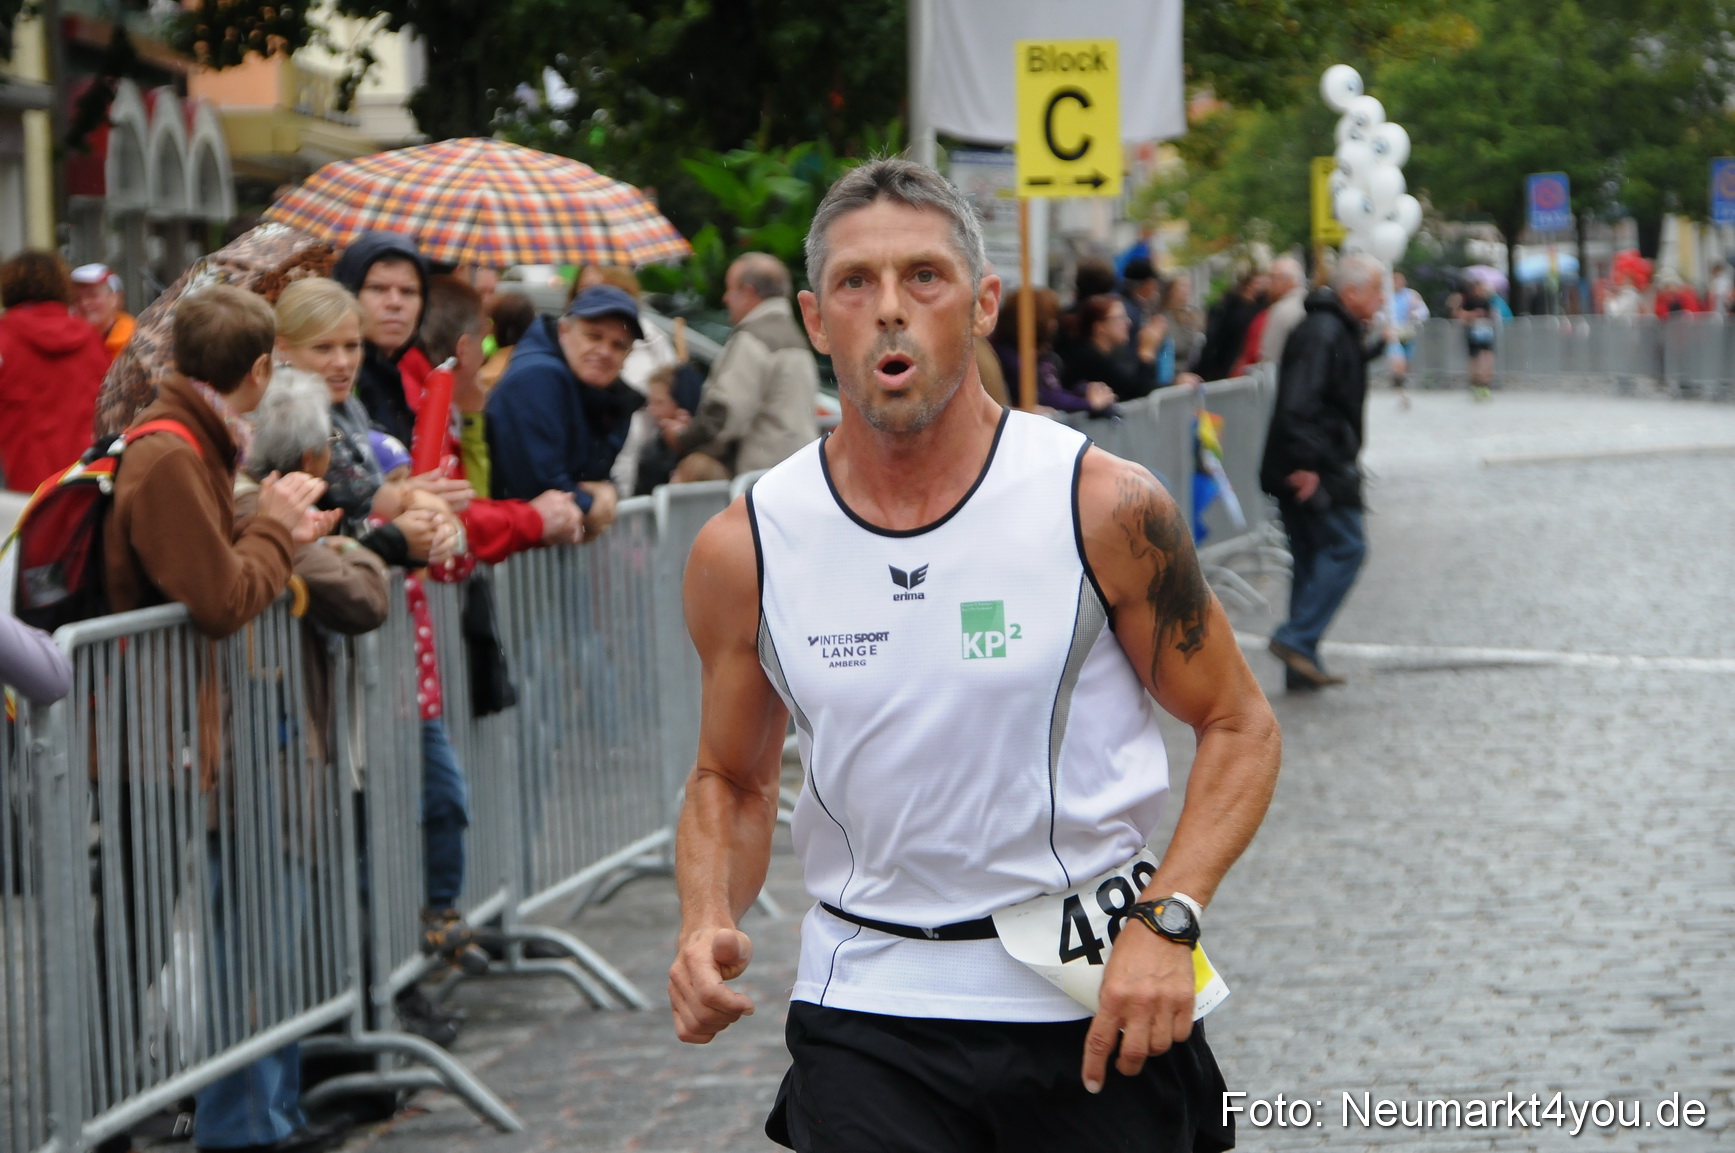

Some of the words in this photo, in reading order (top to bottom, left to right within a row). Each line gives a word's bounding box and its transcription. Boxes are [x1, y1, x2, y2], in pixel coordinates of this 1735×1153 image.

[1028, 45, 1108, 73] Block
[1044, 86, 1092, 162] C
[893, 592, 925, 601] erima
[820, 631, 890, 645] INTERSPORT
[822, 644, 878, 659] LANGE
[828, 659, 867, 668] AMBERG
